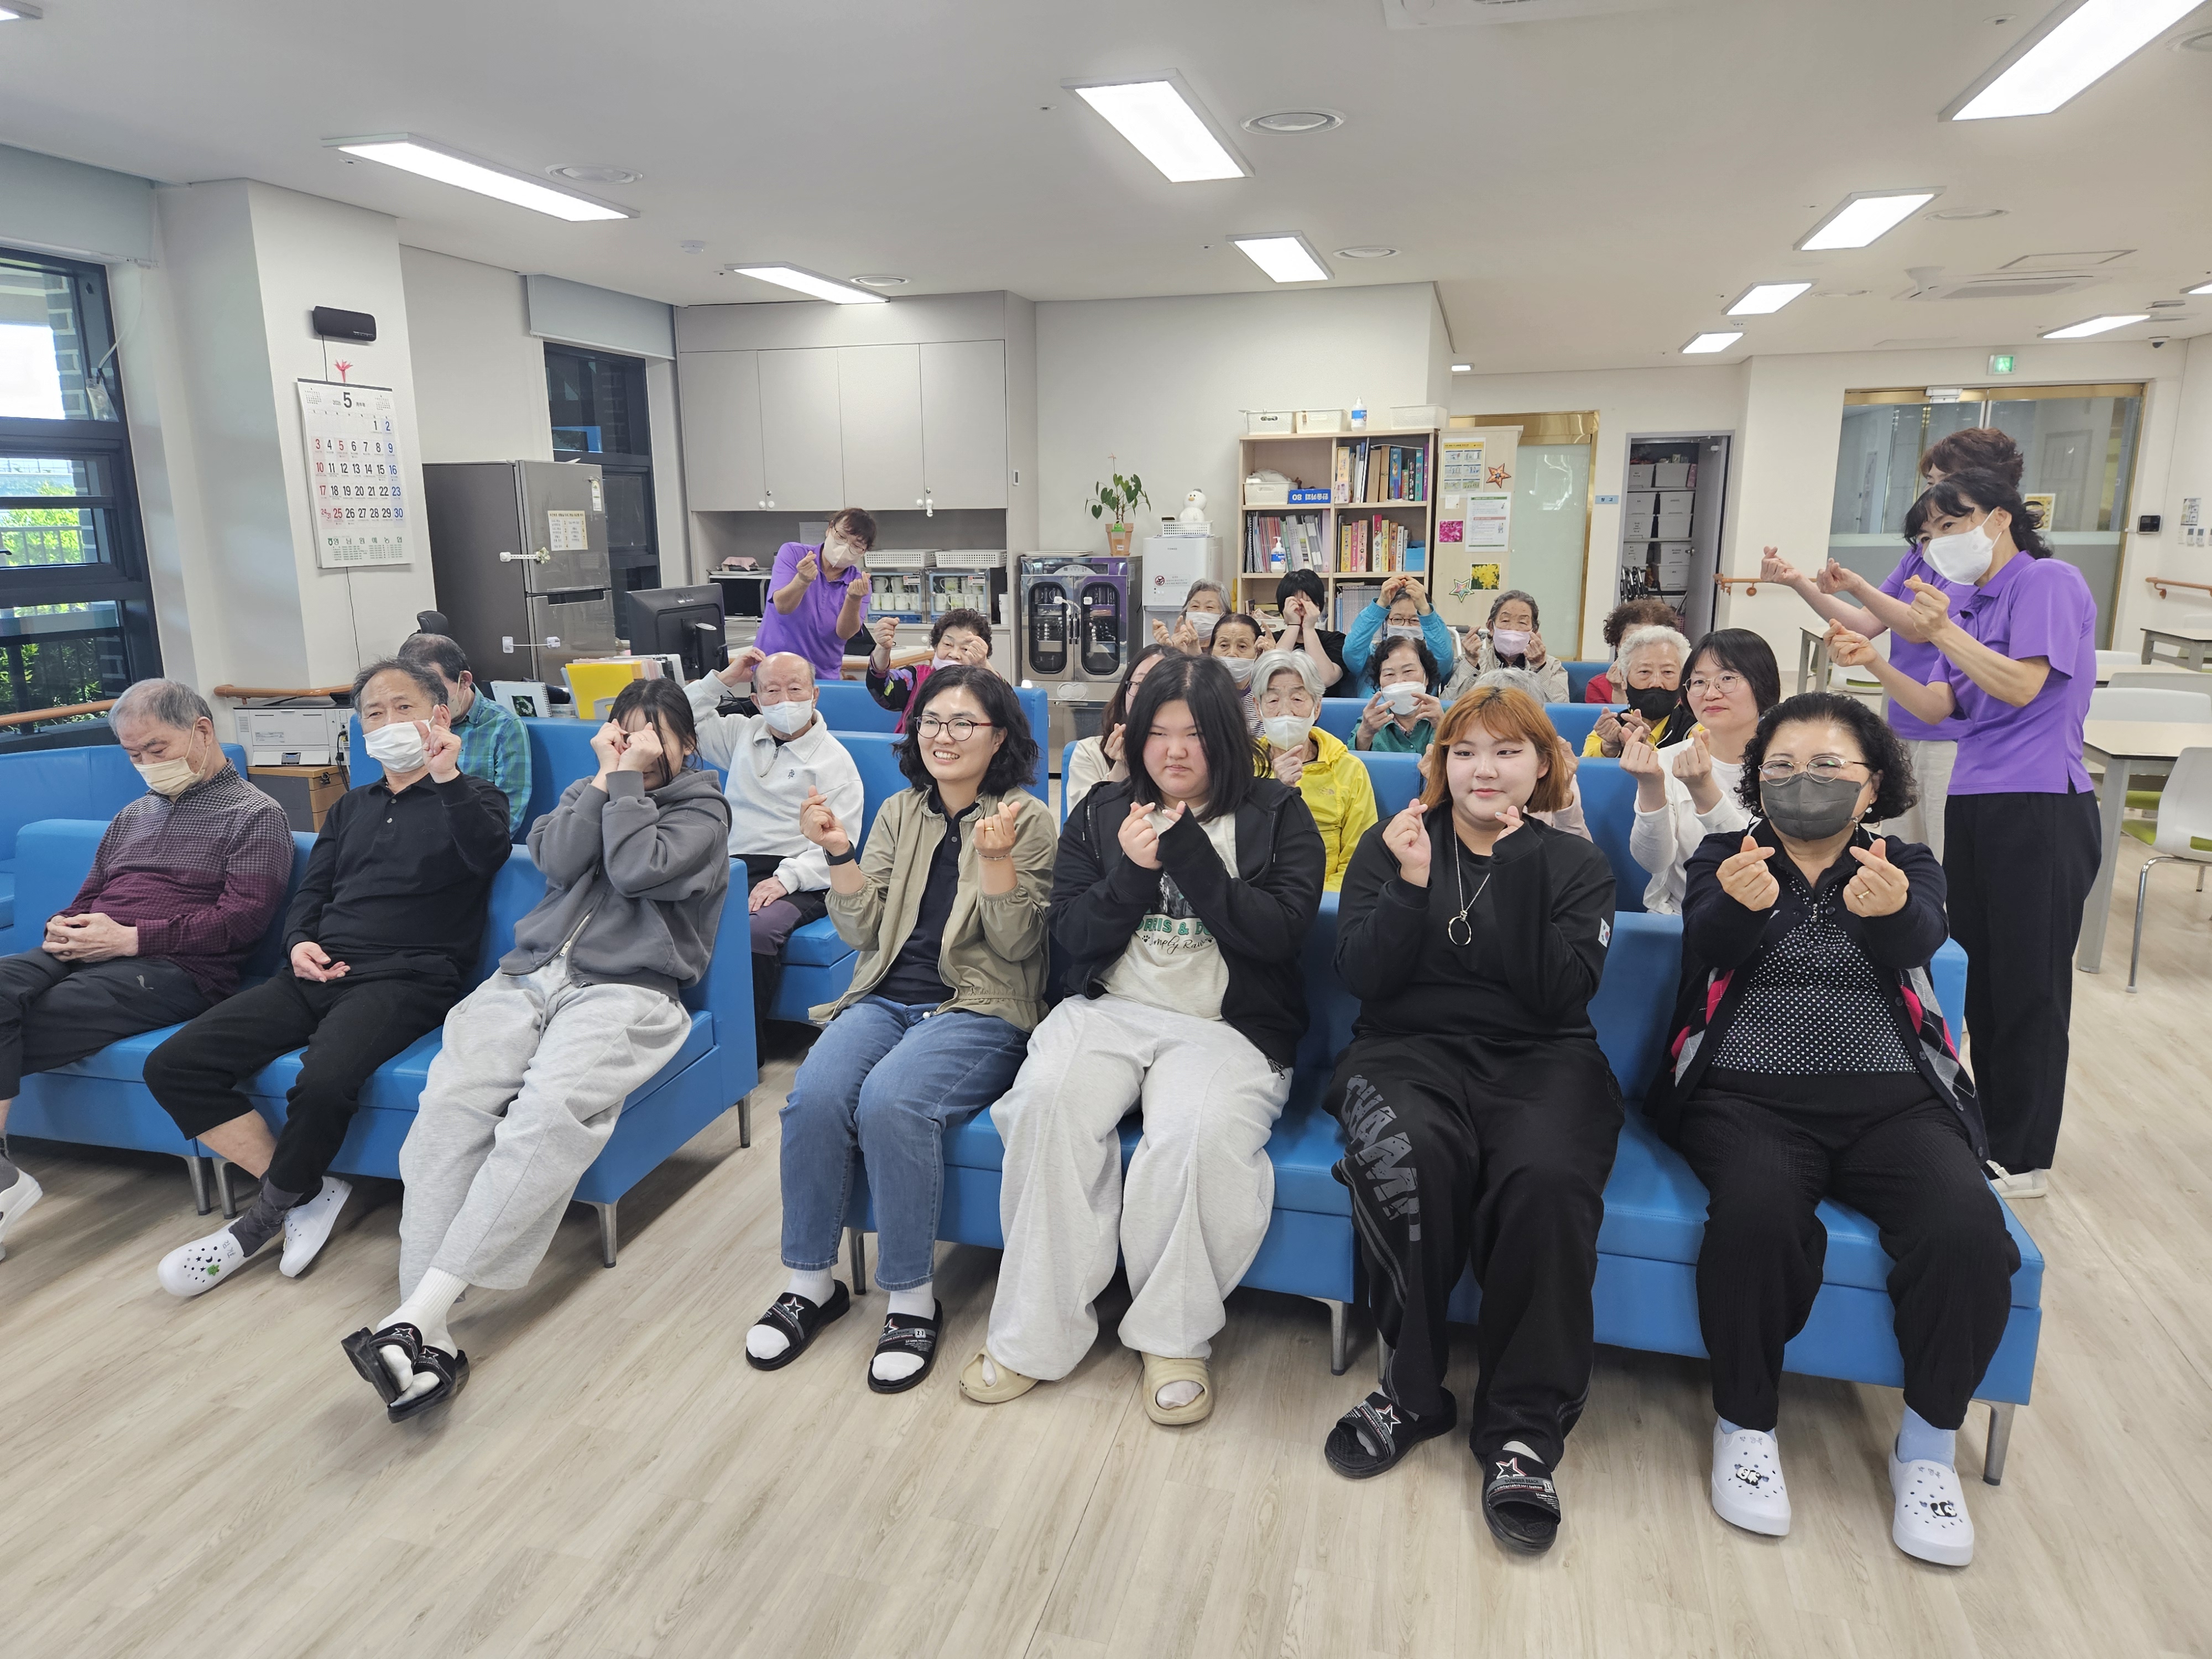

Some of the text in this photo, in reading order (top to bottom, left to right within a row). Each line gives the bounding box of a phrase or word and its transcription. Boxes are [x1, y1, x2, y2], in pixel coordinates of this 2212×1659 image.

[343, 392, 352, 408] 5
[373, 420, 390, 431] 1 2
[315, 439, 393, 453] 3 4 5 6 7 8 9
[316, 462, 397, 474] 10 11 12 13 14 15 16
[319, 485, 401, 496] 17 18 19 20 21 22 23
[333, 508, 343, 519] 25
[345, 508, 355, 518] 26
[358, 508, 366, 518] 27
[369, 508, 379, 518] 28
[382, 508, 392, 518] 29
[394, 508, 403, 518] 30
[1178, 922, 1190, 935] &
[1374, 1416, 1385, 1431] BEACH
